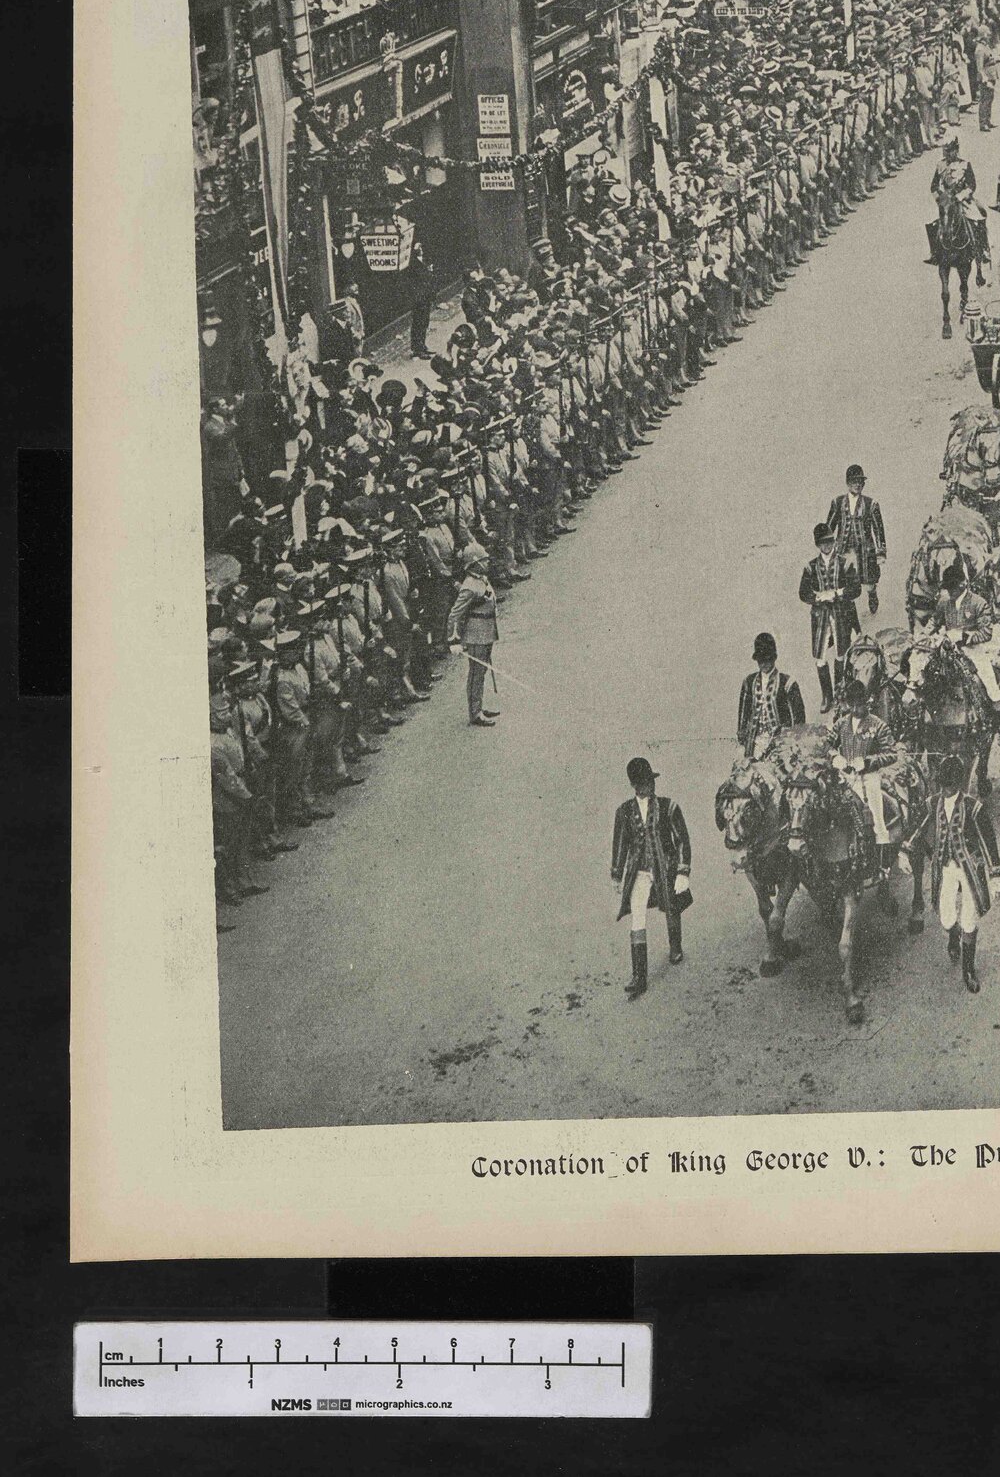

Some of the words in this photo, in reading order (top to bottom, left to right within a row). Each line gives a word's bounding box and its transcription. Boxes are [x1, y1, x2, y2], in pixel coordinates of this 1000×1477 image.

[369, 258, 397, 267] ROOMS
[472, 1154, 605, 1178] Coronation
[625, 1152, 650, 1174] of
[668, 1152, 727, 1176] King
[746, 1150, 829, 1174] George
[910, 1144, 957, 1168] The
[104, 1351, 124, 1361] cm
[104, 1376, 145, 1388] Inches
[396, 1379, 403, 1389] 2
[544, 1379, 552, 1390] 3
[271, 1399, 312, 1411] NZMS
[355, 1399, 453, 1411] micrographics.co.nz
